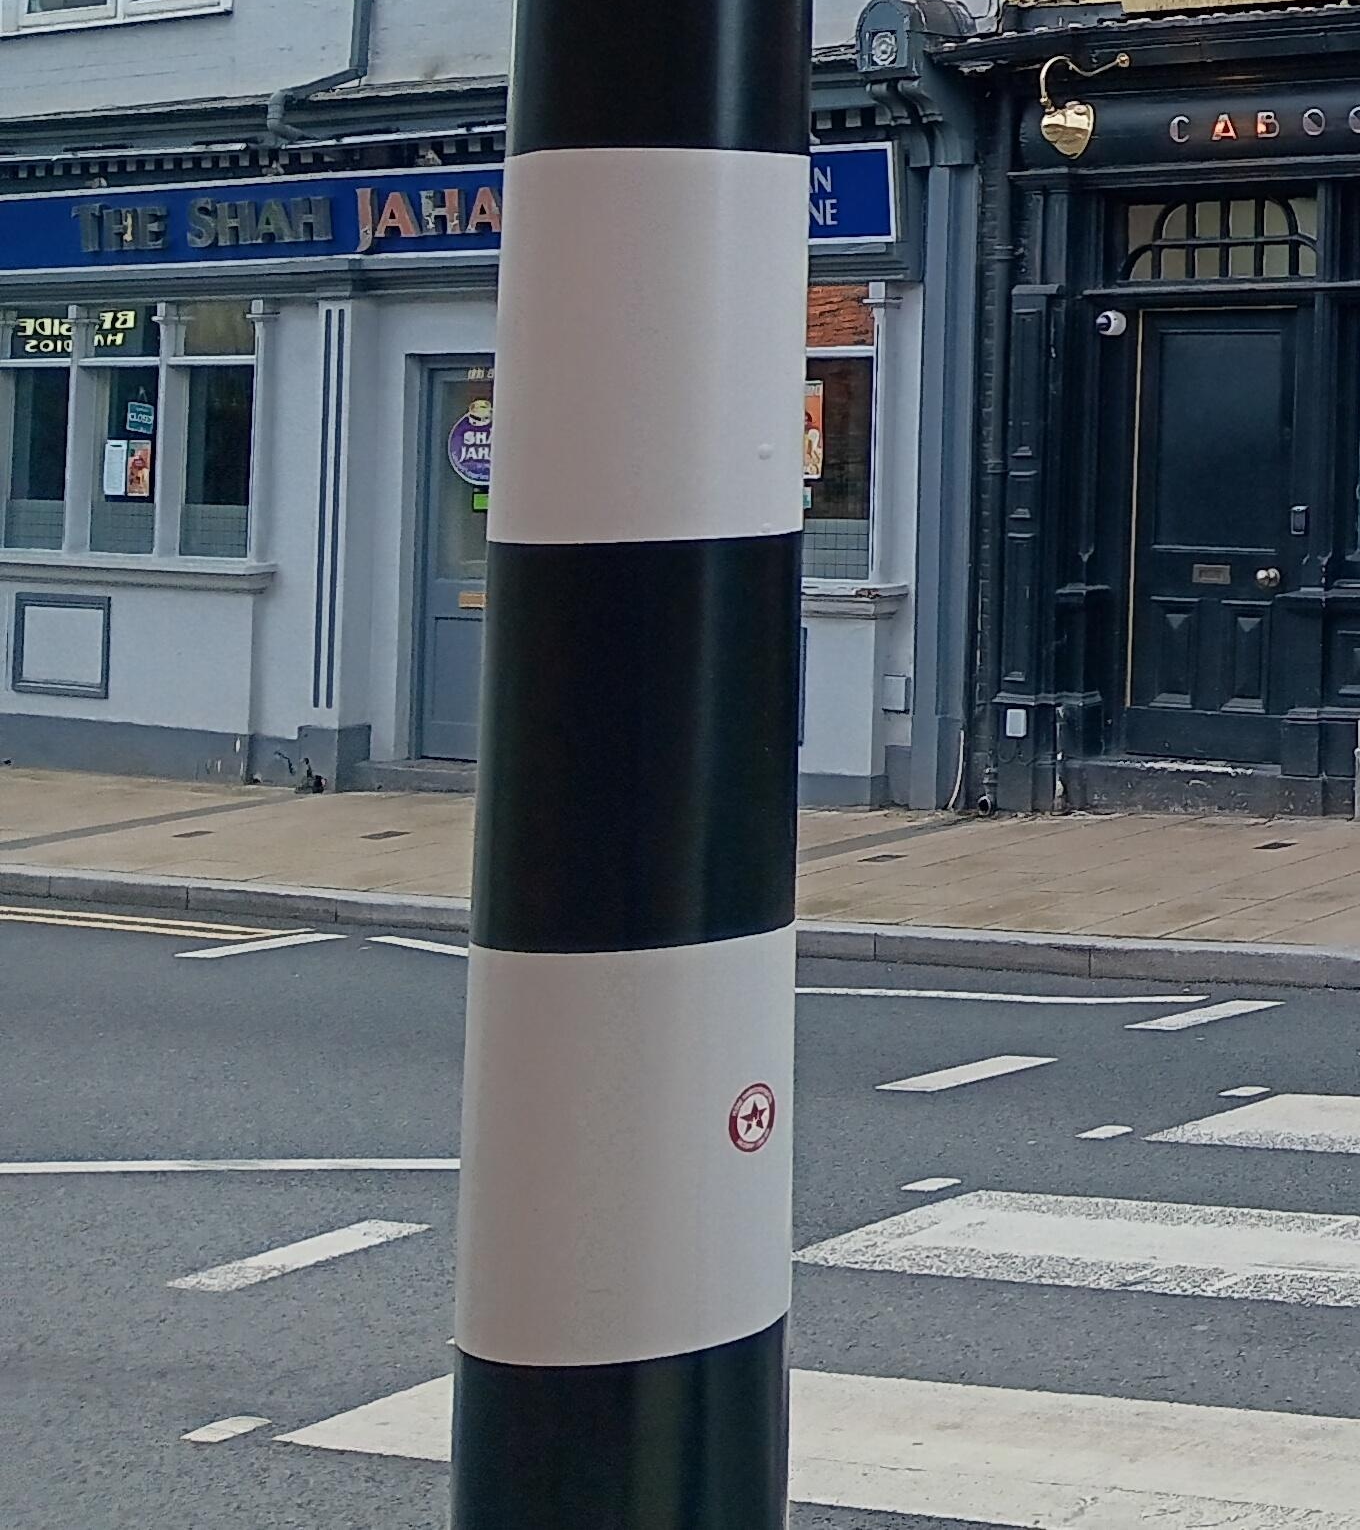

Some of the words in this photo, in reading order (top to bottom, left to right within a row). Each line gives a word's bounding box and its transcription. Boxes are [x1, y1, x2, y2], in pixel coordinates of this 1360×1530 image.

[71, 202, 169, 253] THE
[187, 196, 333, 248] SHAH
[355, 185, 500, 253] JAHA
